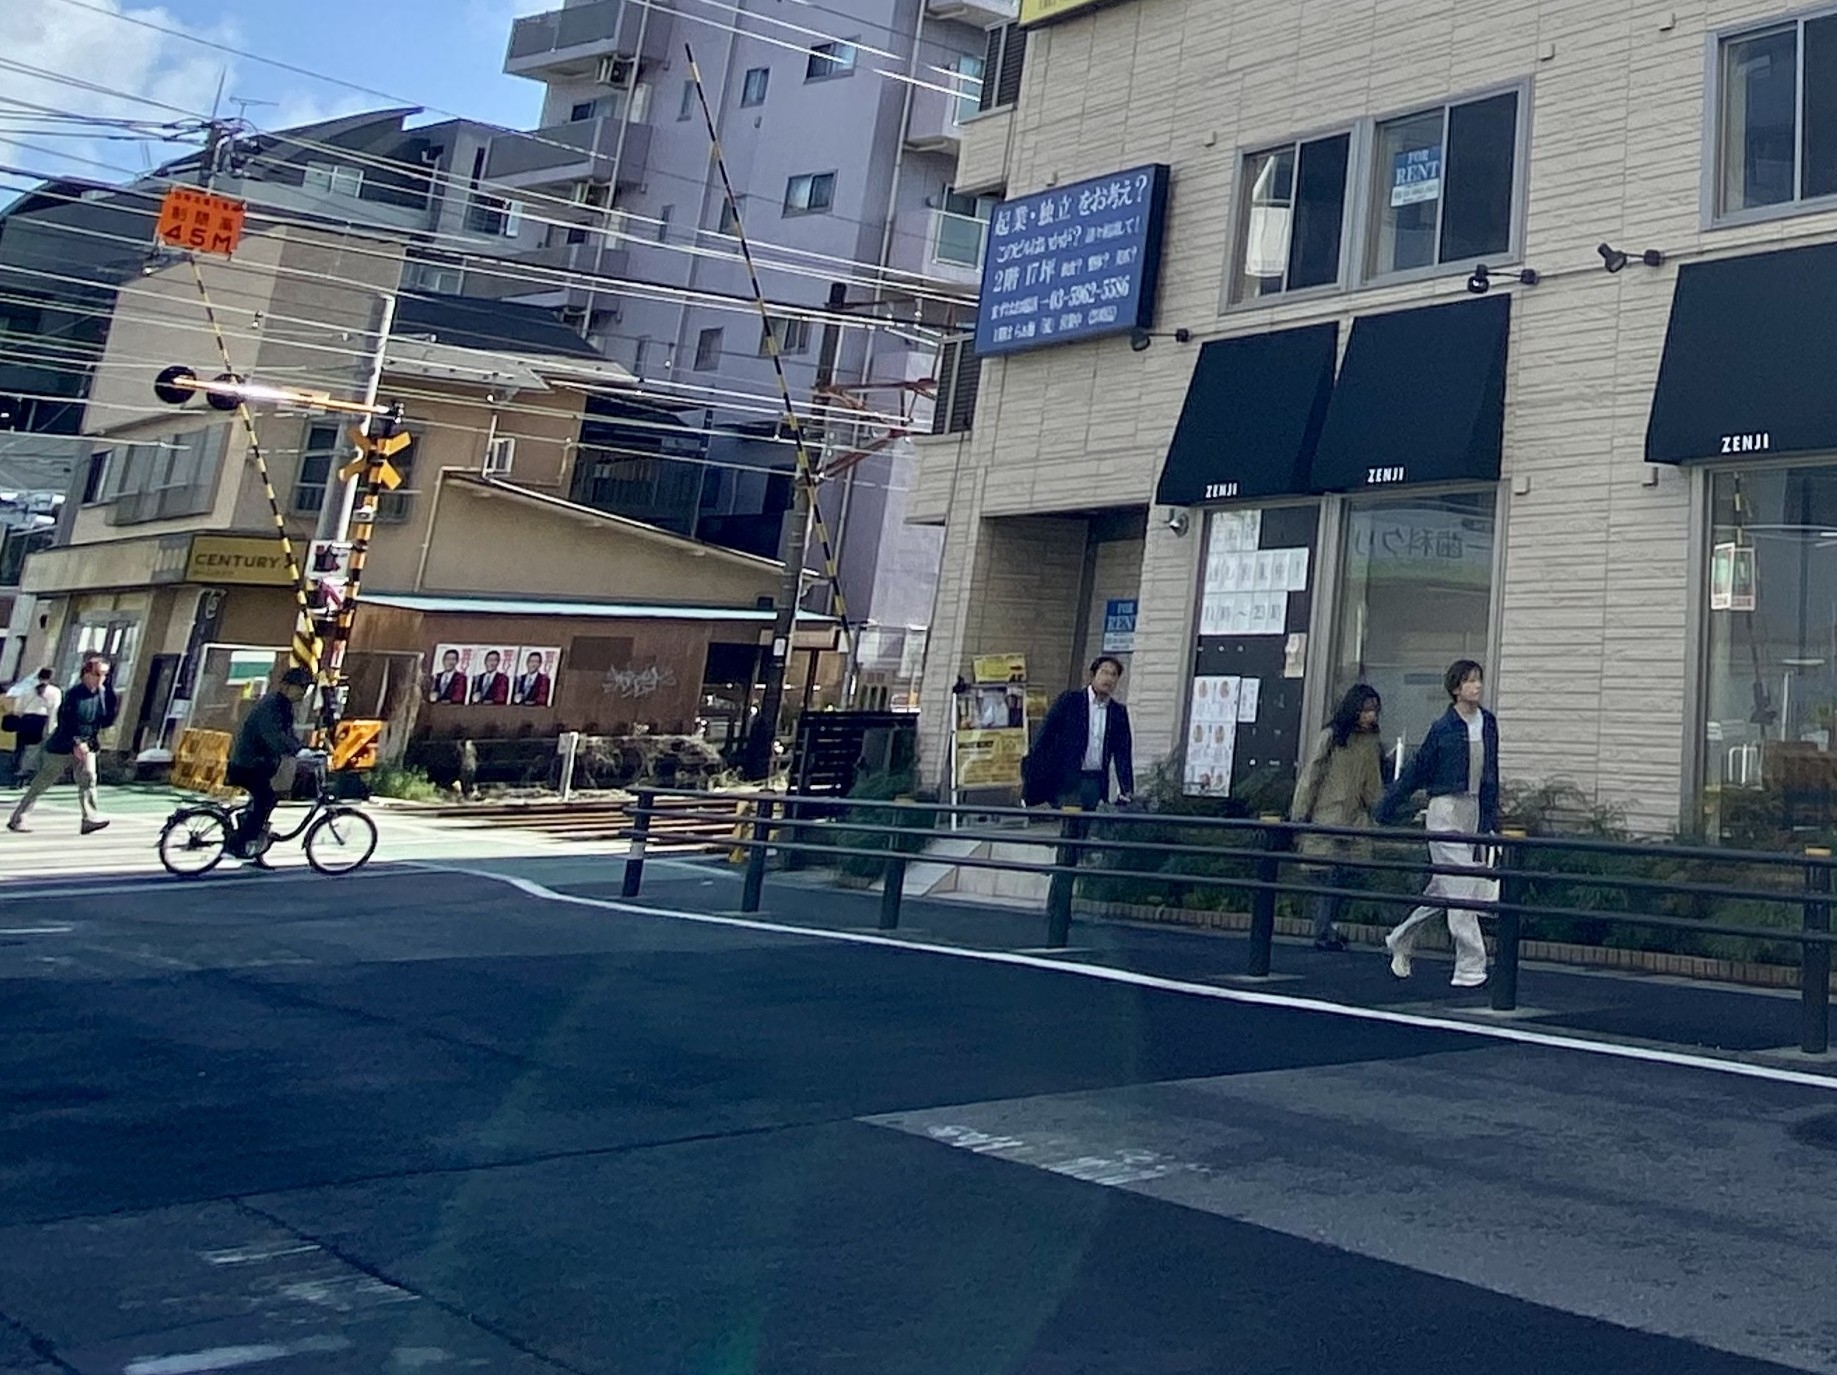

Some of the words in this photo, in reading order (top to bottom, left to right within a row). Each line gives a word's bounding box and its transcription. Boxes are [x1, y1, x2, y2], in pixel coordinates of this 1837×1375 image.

[1395, 160, 1440, 185] RENT
[994, 194, 1073, 236] 起業・独立
[1721, 432, 1770, 453] ZENJI
[1367, 466, 1405, 483] ZENJI
[1205, 482, 1238, 499] ZENJI
[194, 553, 280, 569] CENTURY
[1107, 615, 1136, 631] REN
